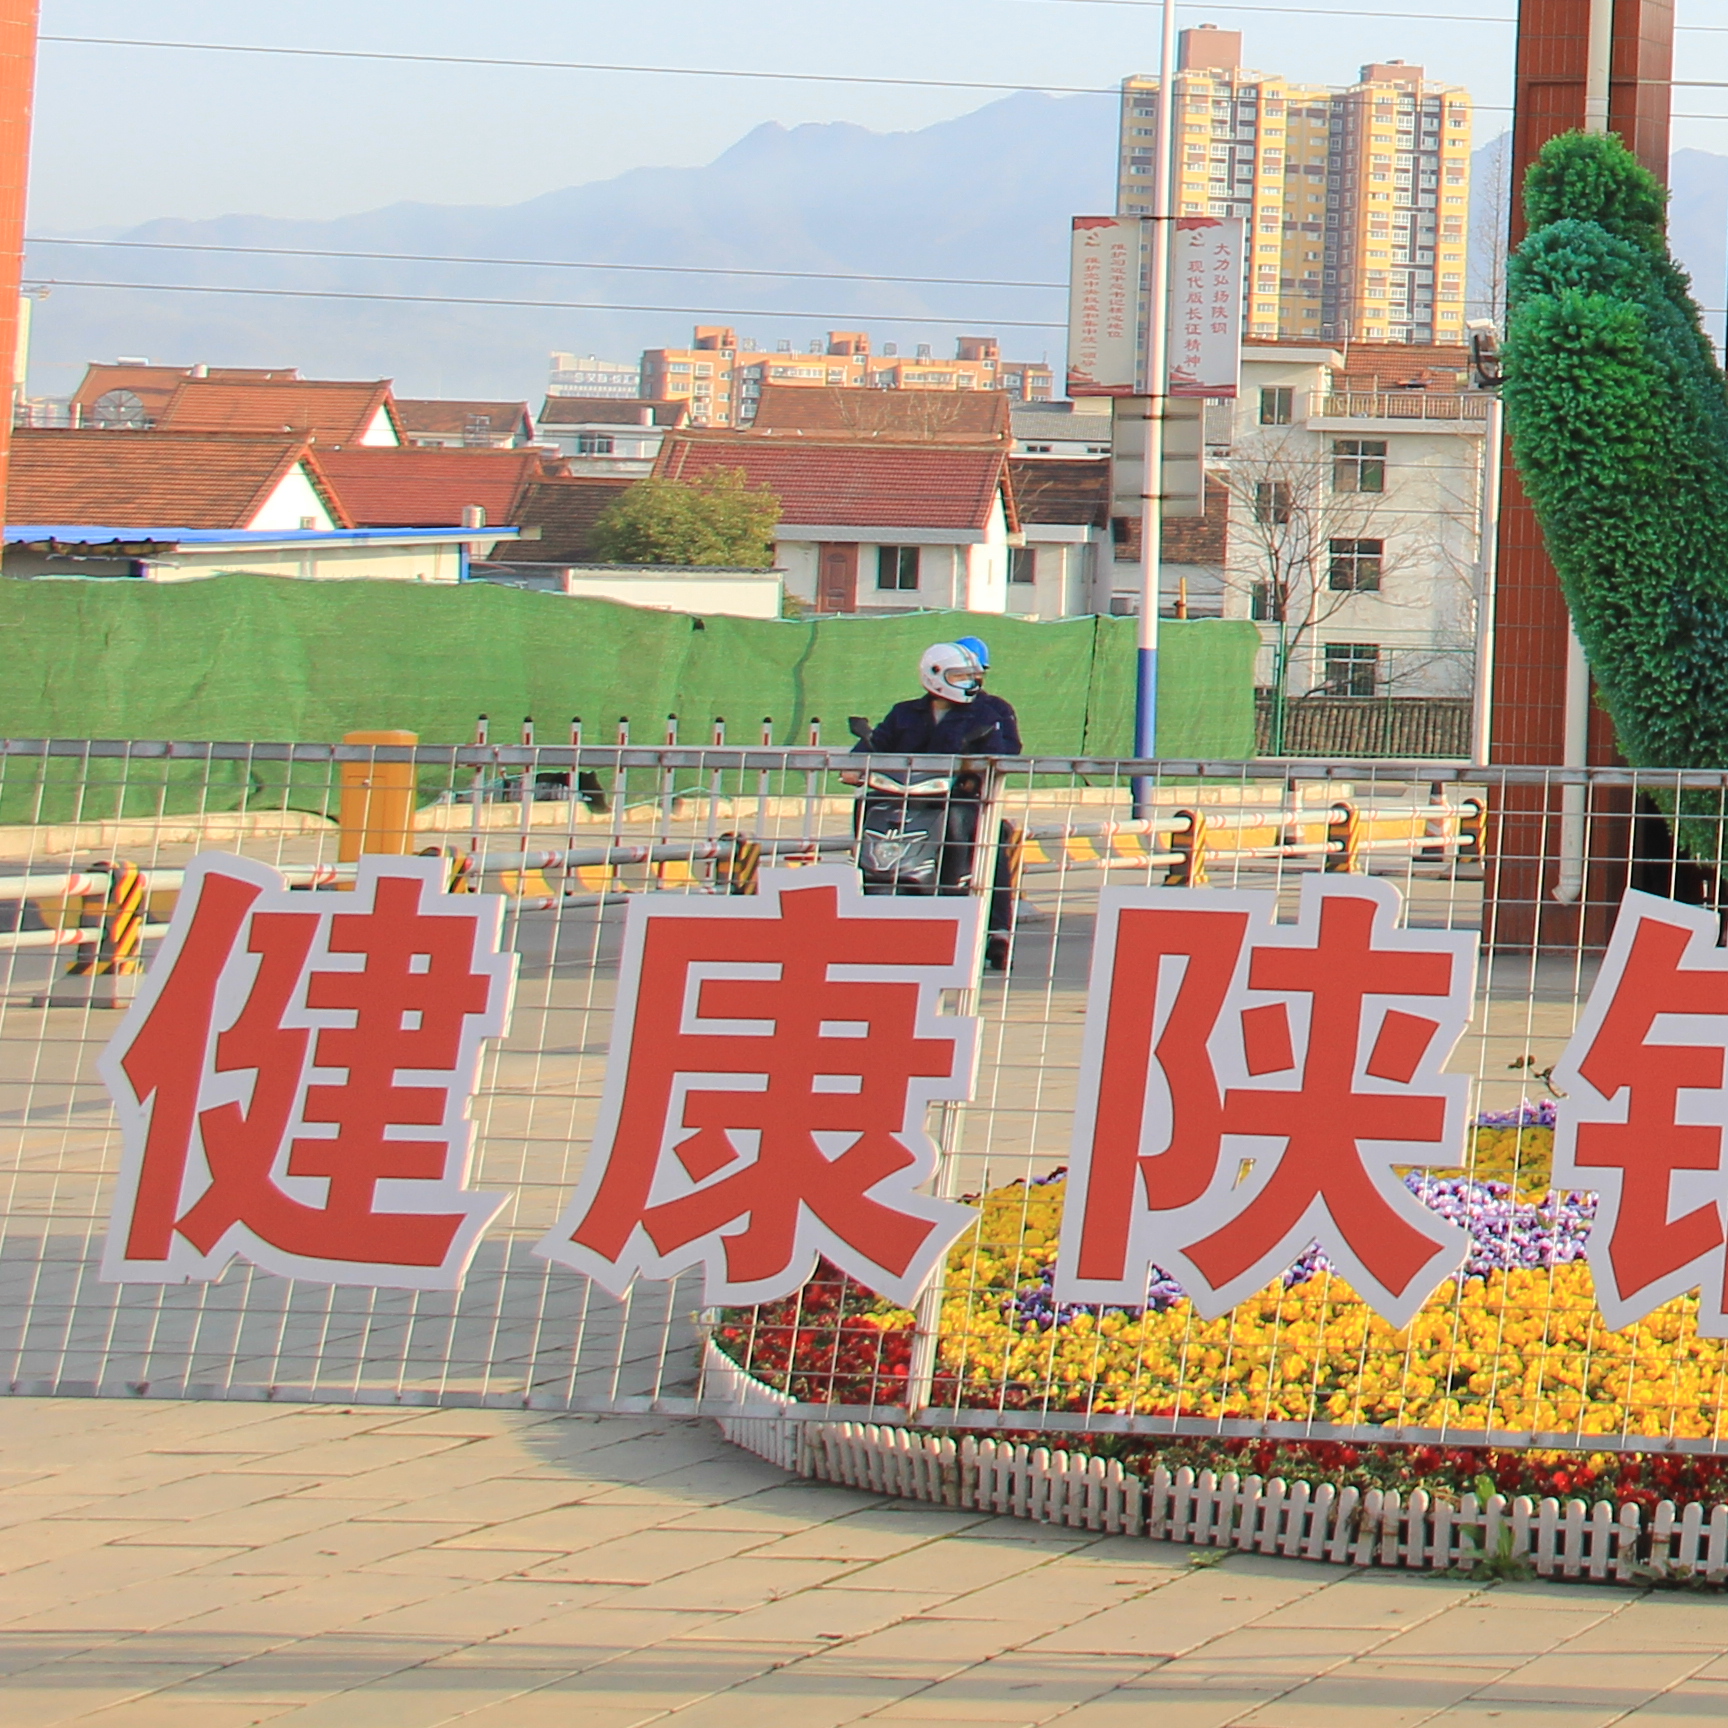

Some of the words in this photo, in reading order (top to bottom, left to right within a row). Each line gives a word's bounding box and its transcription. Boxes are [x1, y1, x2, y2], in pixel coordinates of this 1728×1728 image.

[1183, 259, 1204, 367] 现代版长征精神
[1209, 242, 1230, 334] 大力弘扬陕钢
